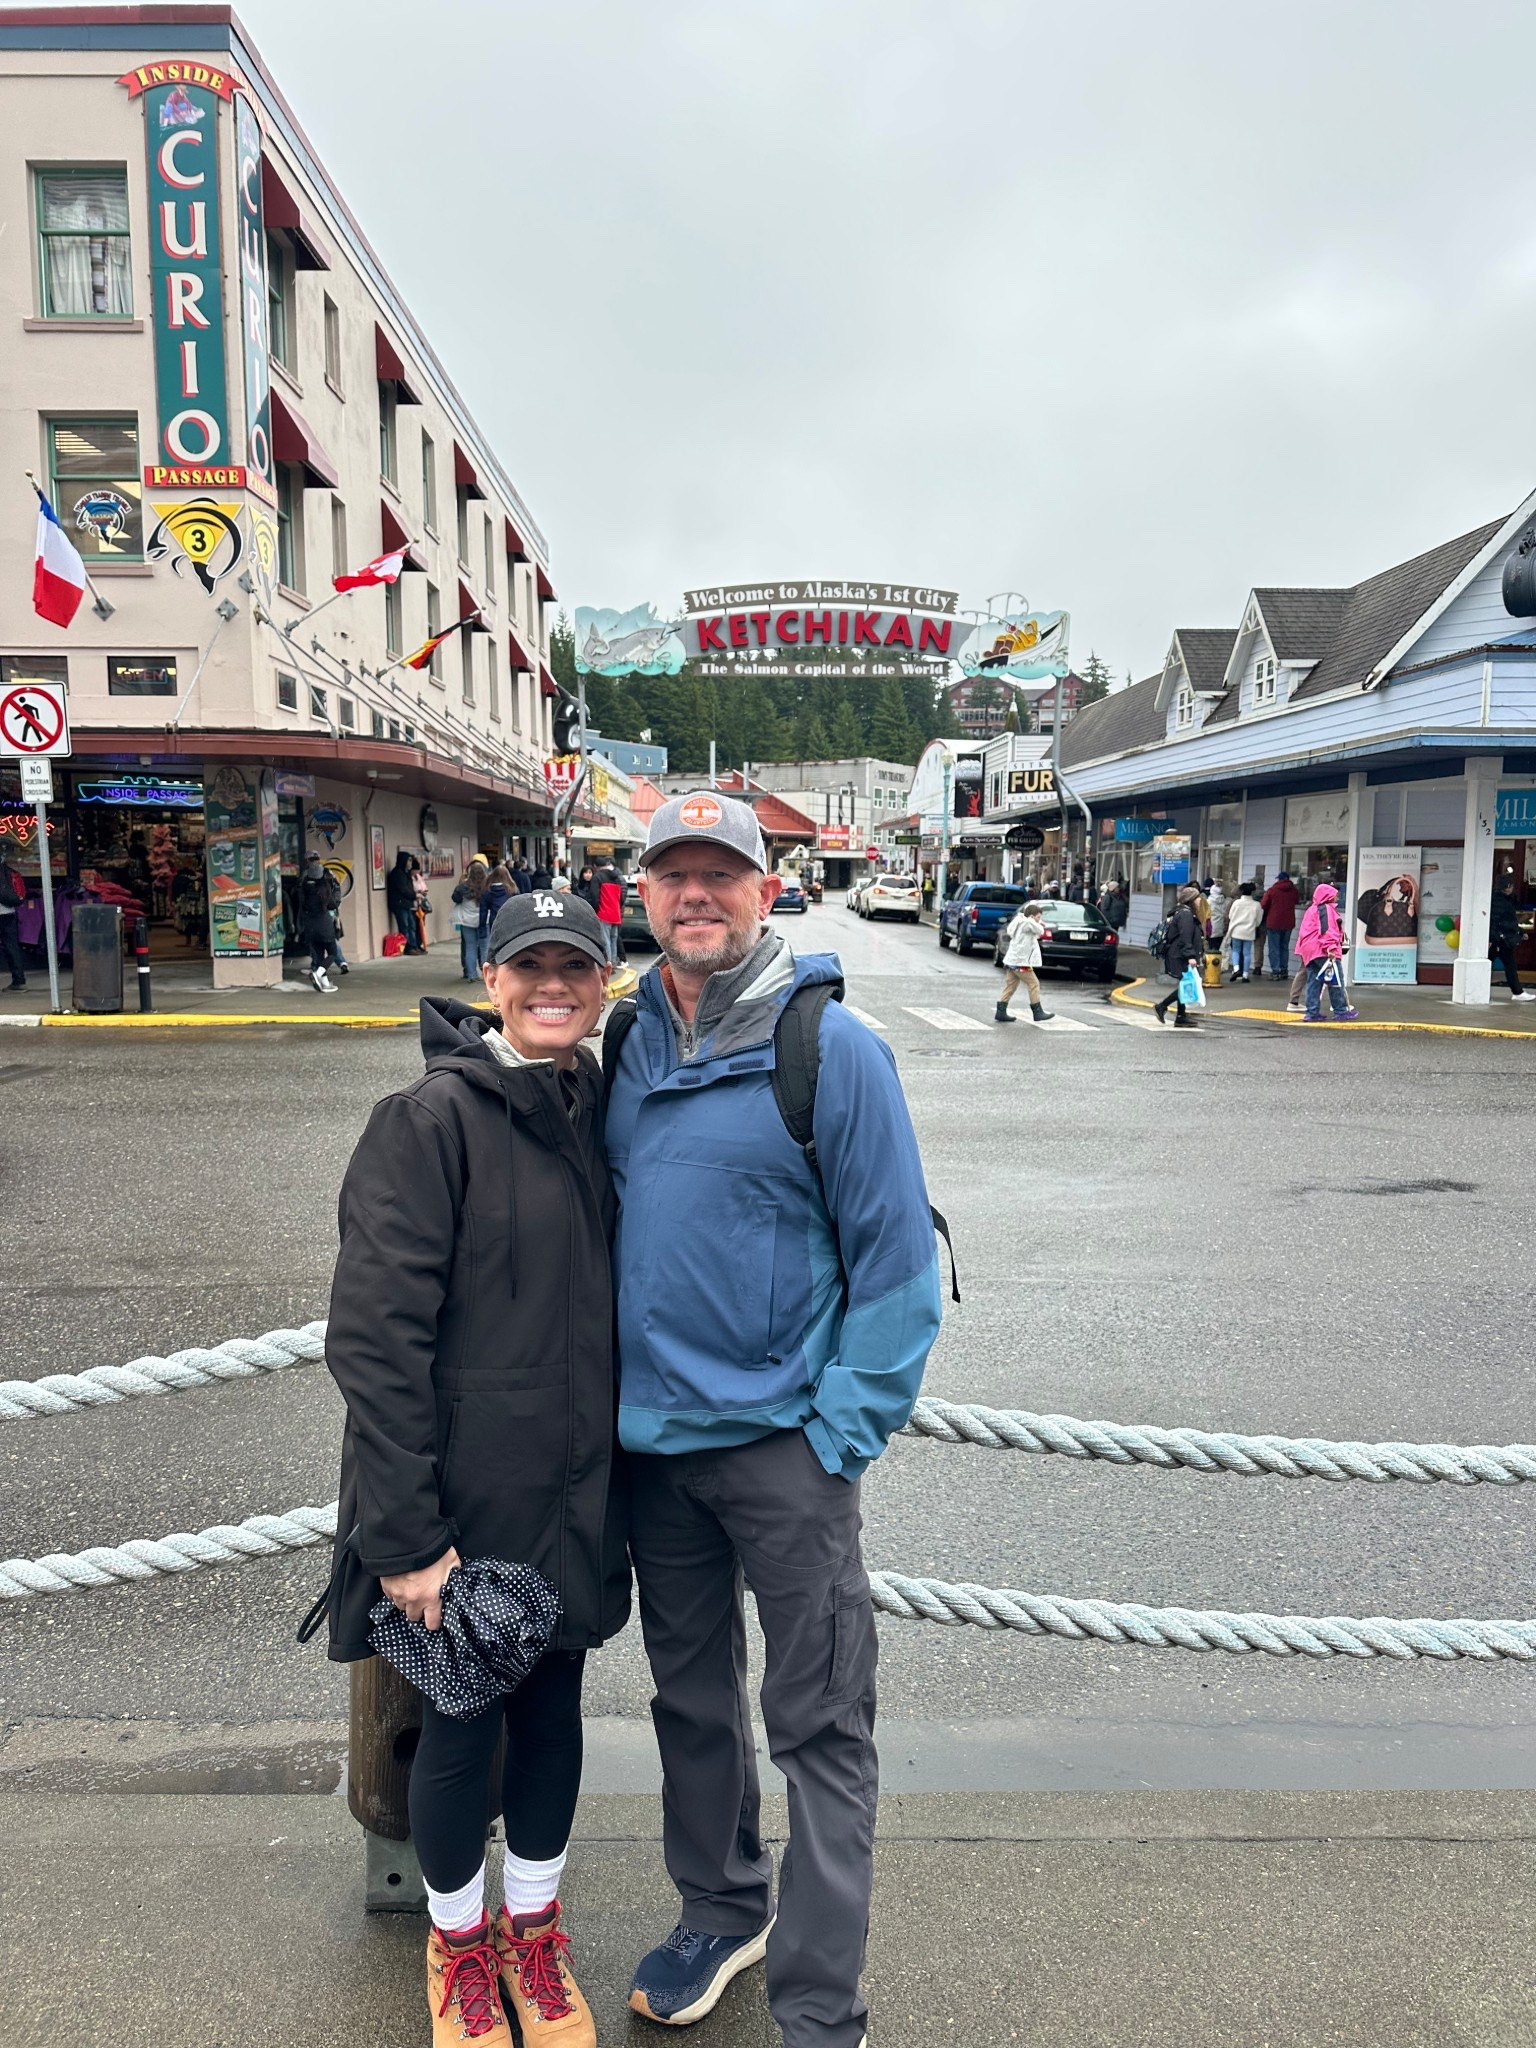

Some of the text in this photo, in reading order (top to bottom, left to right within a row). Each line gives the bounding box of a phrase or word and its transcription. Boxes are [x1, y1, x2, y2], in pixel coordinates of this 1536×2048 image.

[136, 63, 225, 90] INSIDE
[158, 130, 221, 466] CURIO
[242, 155, 270, 477] CURIO
[152, 467, 240, 485] PASSAGE
[191, 529, 206, 552] 3
[691, 582, 952, 612] Welcome to Alaska's 1st City
[697, 610, 953, 653] KETCHIKAN
[699, 663, 944, 679] The Salmon Capital of the World
[30, 765, 42, 775] NO
[1010, 770, 1054, 792] FUR
[101, 788, 194, 800] INSIDE PASSAGE
[691, 805, 710, 819] T
[17, 827, 29, 840] 3
[1121, 822, 1170, 834] MILANO
[533, 892, 564, 918] LA
